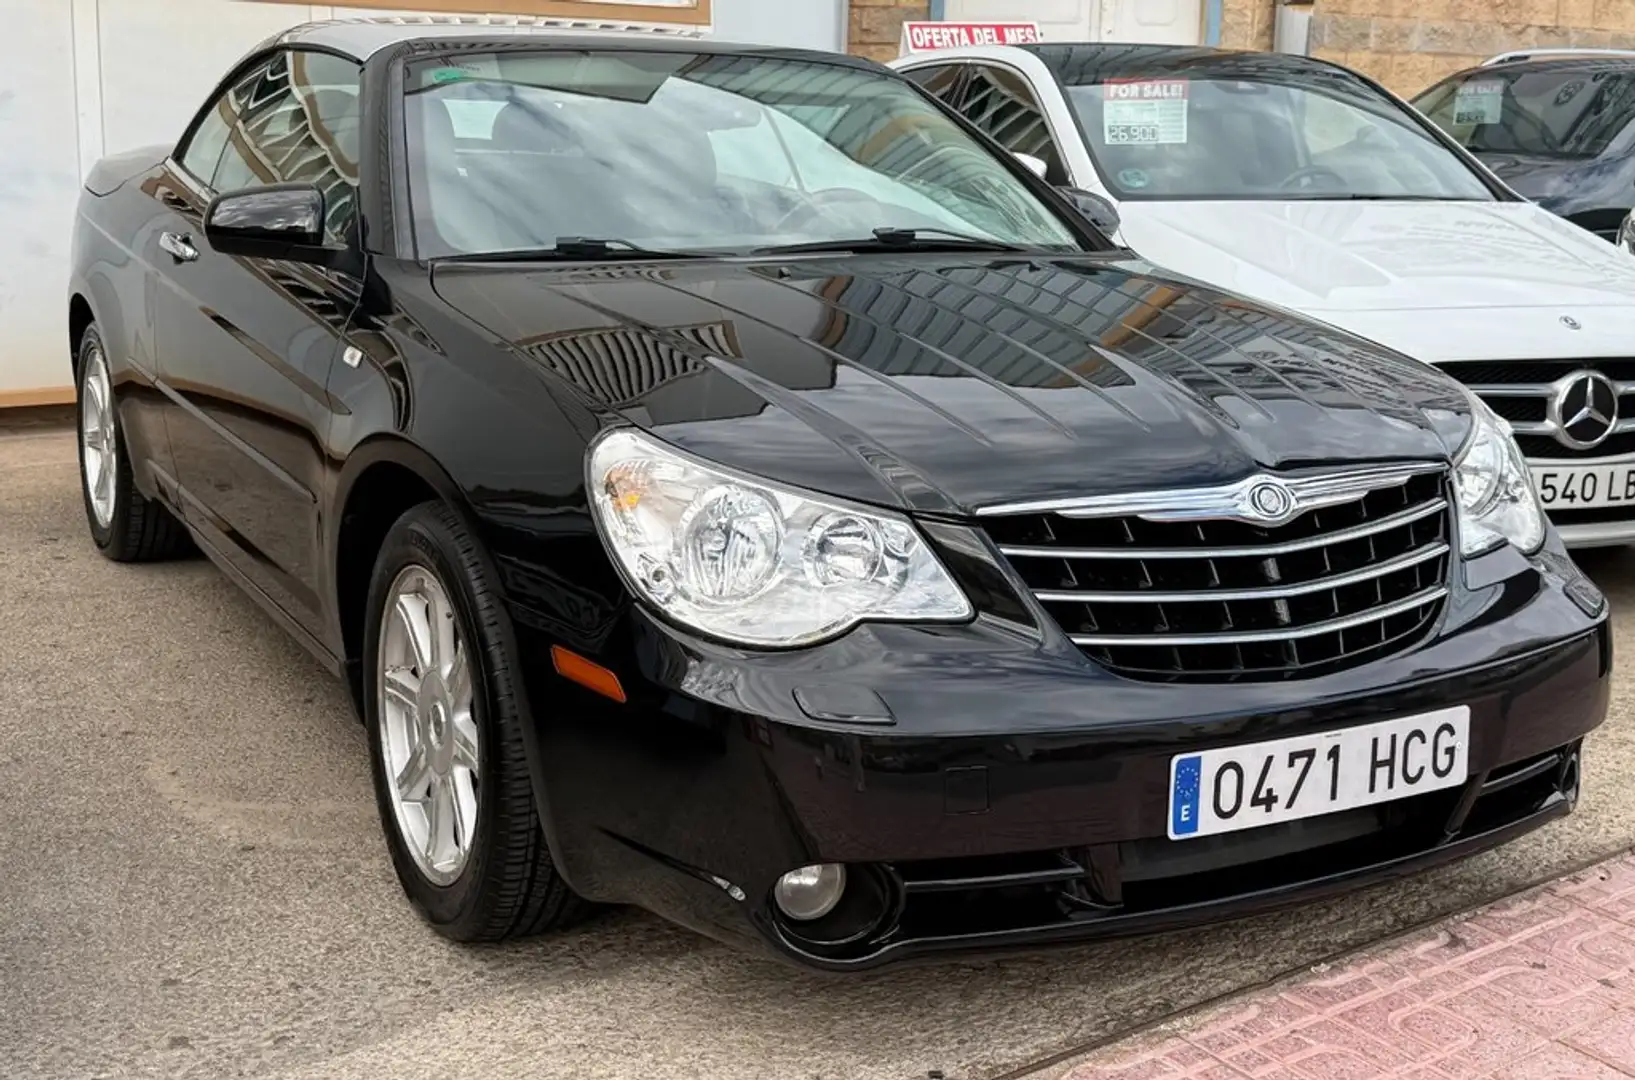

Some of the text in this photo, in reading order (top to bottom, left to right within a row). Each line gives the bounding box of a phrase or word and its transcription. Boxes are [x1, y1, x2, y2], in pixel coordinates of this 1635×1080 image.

[911, 26, 1035, 48] OFERTA DEL MES
[1110, 84, 1139, 98] FOR
[1531, 471, 1597, 504] 540
[1213, 722, 1457, 820] 0471 HCG
[1180, 804, 1191, 822] E
